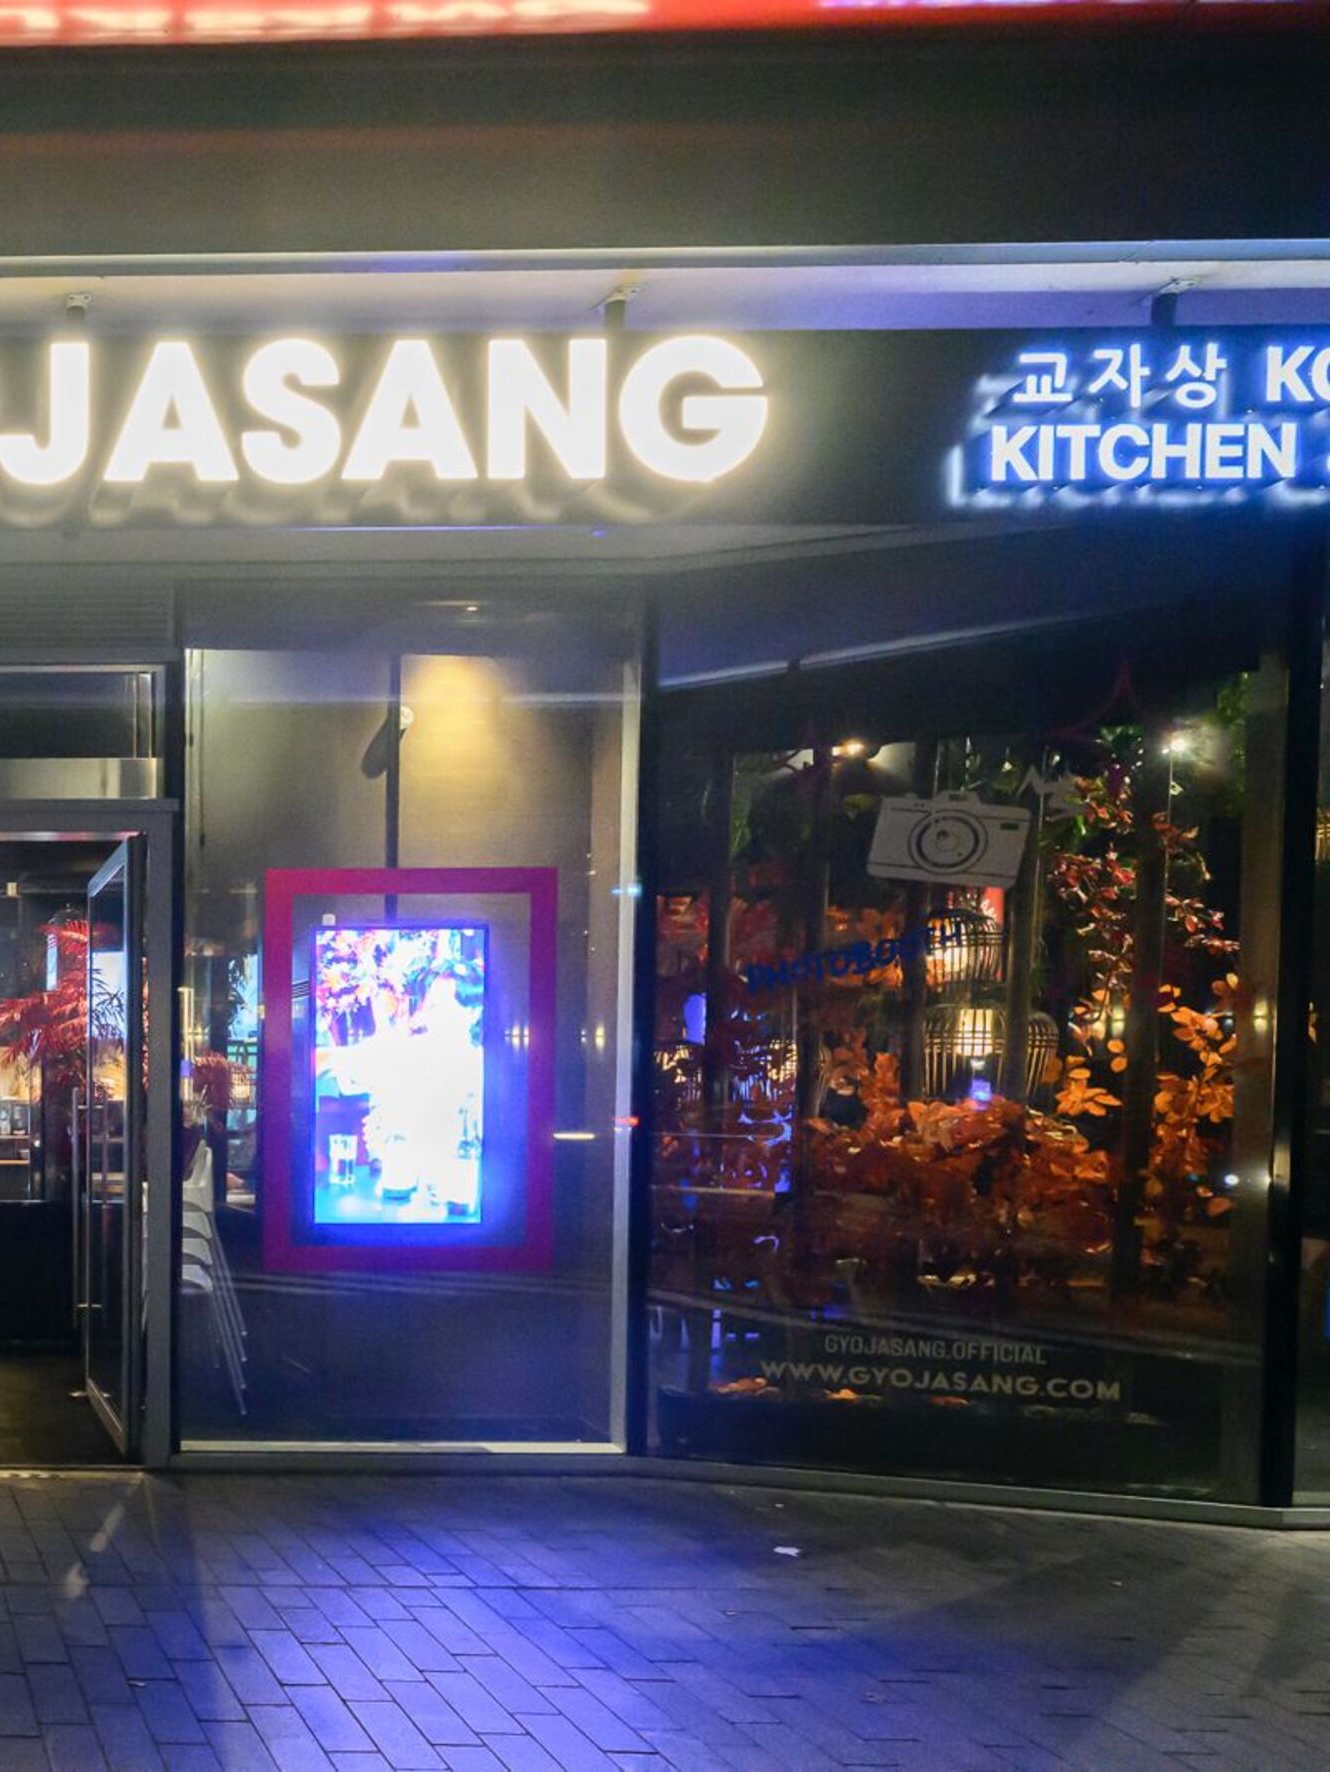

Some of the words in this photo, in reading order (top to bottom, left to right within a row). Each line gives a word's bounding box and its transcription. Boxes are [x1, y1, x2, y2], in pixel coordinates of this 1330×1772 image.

[1012, 341, 1227, 408] 교자상
[990, 422, 1297, 481] KITCHEN
[760, 1360, 1121, 1401] WWW.GYOJASANG.COM
